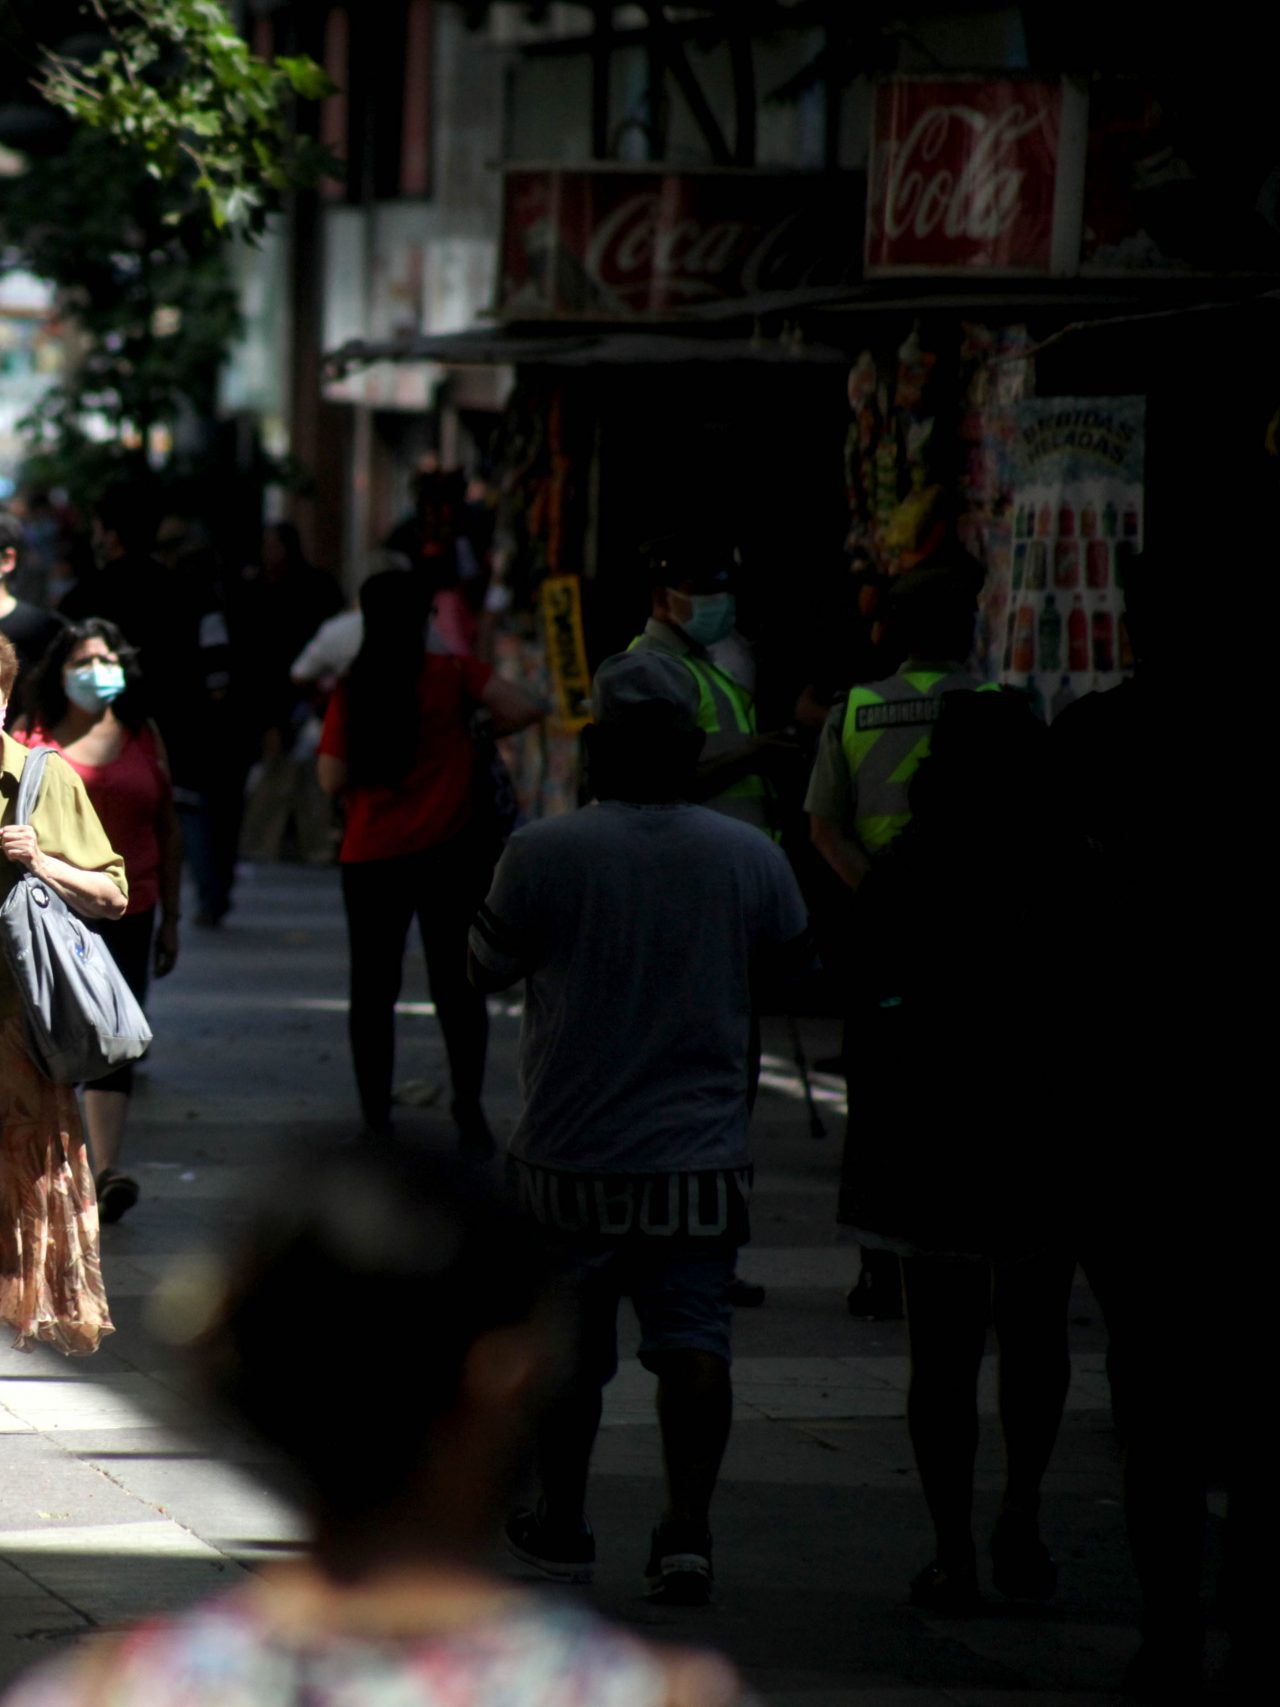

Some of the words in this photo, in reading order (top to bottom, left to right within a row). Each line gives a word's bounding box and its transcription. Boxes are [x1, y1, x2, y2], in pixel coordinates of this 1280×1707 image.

[884, 103, 1048, 241] Cola
[586, 192, 745, 284] Coca
[1023, 411, 1136, 444] BEBIDAS
